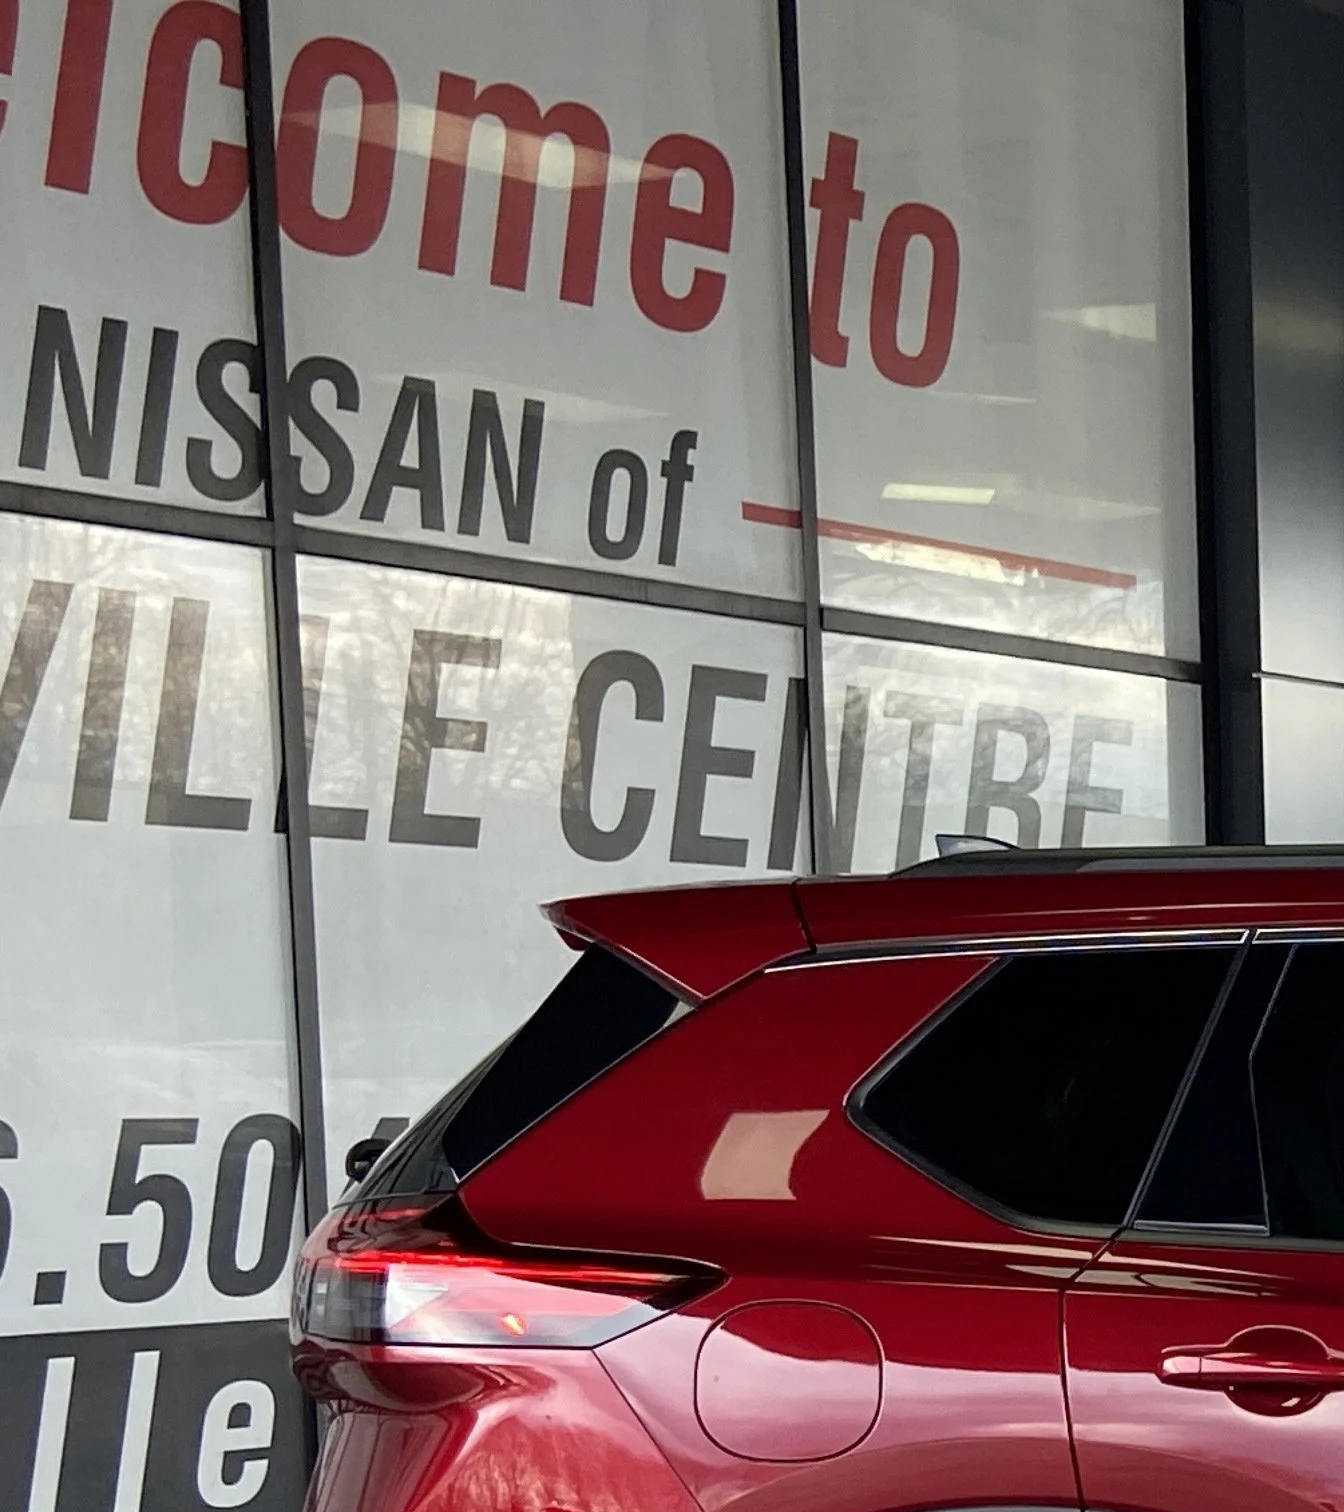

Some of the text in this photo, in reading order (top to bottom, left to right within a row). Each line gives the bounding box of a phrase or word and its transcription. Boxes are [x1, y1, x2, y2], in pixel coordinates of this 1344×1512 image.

[0, 0, 960, 388] lcome to
[18, 304, 698, 568] NISSAN of
[561, 650, 1133, 874] CENTRE
